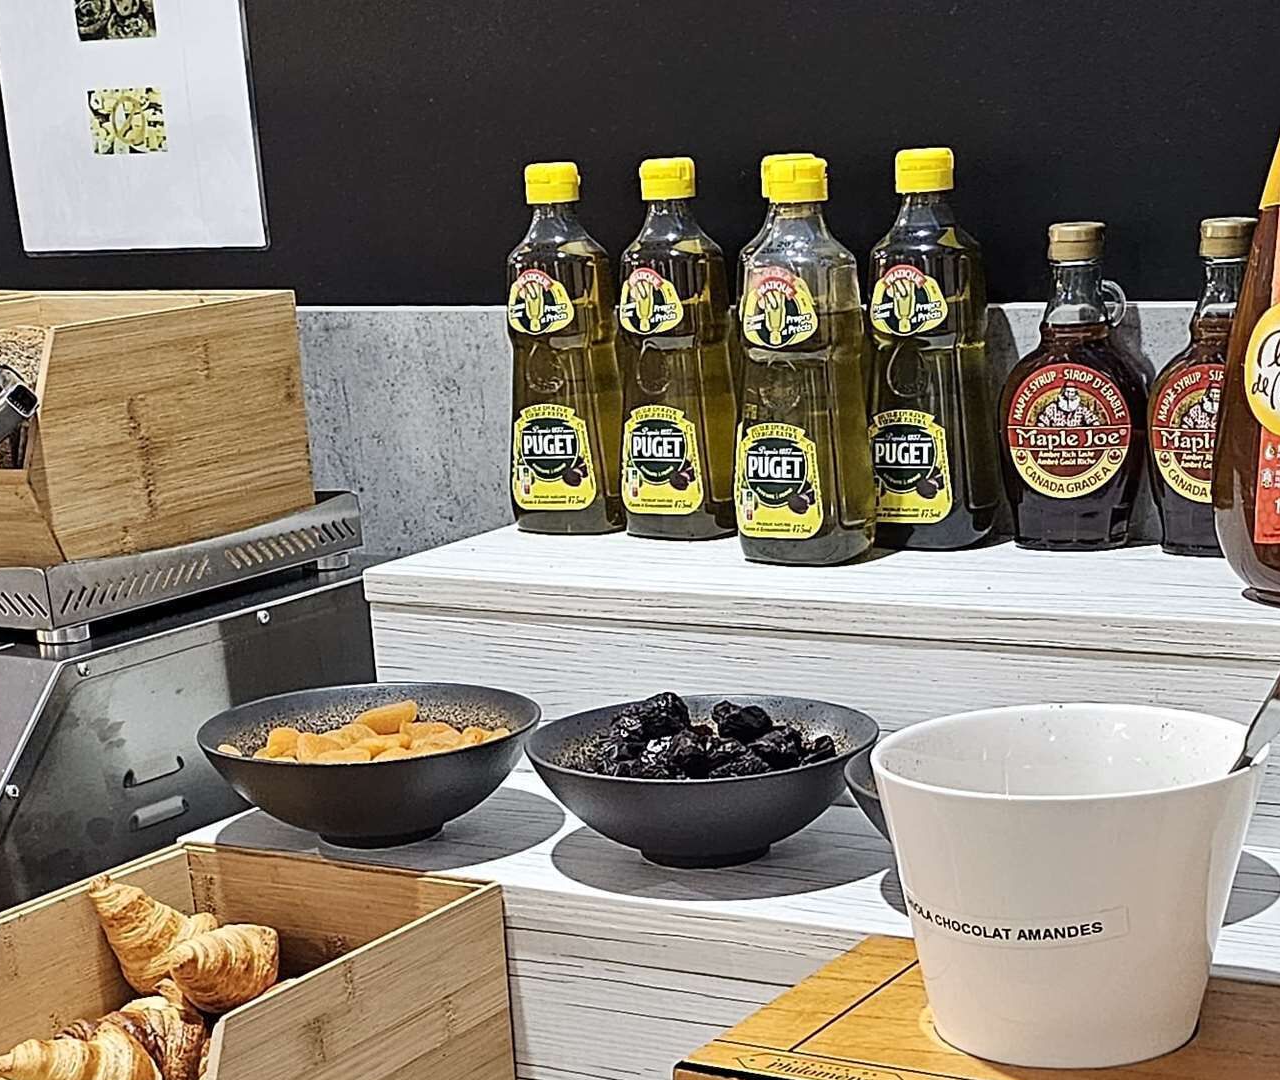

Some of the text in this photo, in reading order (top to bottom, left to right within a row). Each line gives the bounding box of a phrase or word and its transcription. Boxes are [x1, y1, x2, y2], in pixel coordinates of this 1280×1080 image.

[1013, 368, 1126, 420] MAPLE SYRUP SIROP D'ÉRABLE
[1157, 371, 1202, 422] MAPLE SYRUP
[1251, 372, 1269, 397] de
[523, 434, 574, 455] PUGET
[632, 436, 683, 457] PUGET
[1016, 429, 1079, 450] Maple
[874, 441, 932, 464] PUGET
[747, 455, 803, 478] PUGET
[1024, 466, 1112, 493] CANADA GRADE A
[1168, 468, 1209, 497] CANADA
[934, 913, 1104, 941] CHOCOLAT AMANDES
